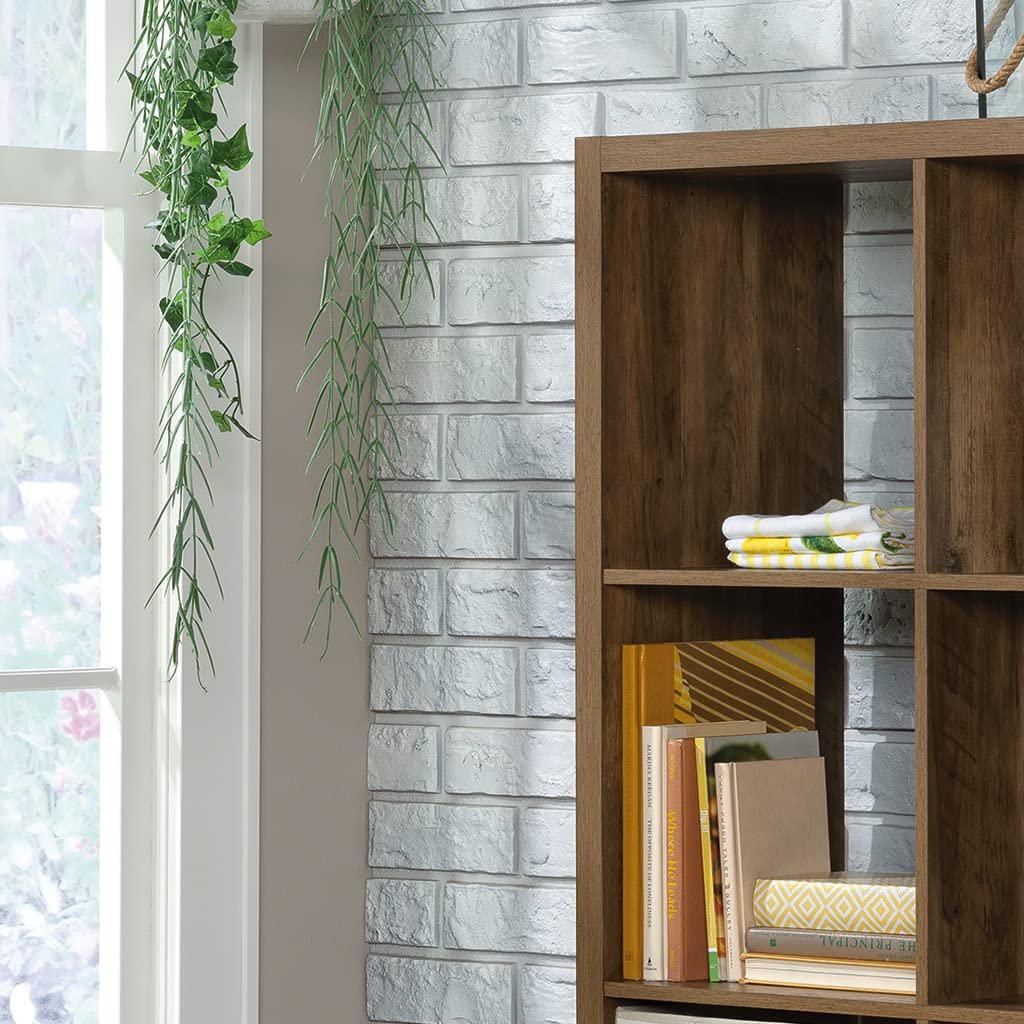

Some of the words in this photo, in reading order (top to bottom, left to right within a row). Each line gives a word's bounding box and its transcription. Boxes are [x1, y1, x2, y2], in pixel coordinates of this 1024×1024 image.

[667, 810, 678, 857] Where
[647, 872, 653, 882] OF
[667, 859, 677, 879] He
[667, 882, 678, 920] Leads
[819, 935, 892, 951] PRINCIPAL
[899, 939, 916, 951] HE
